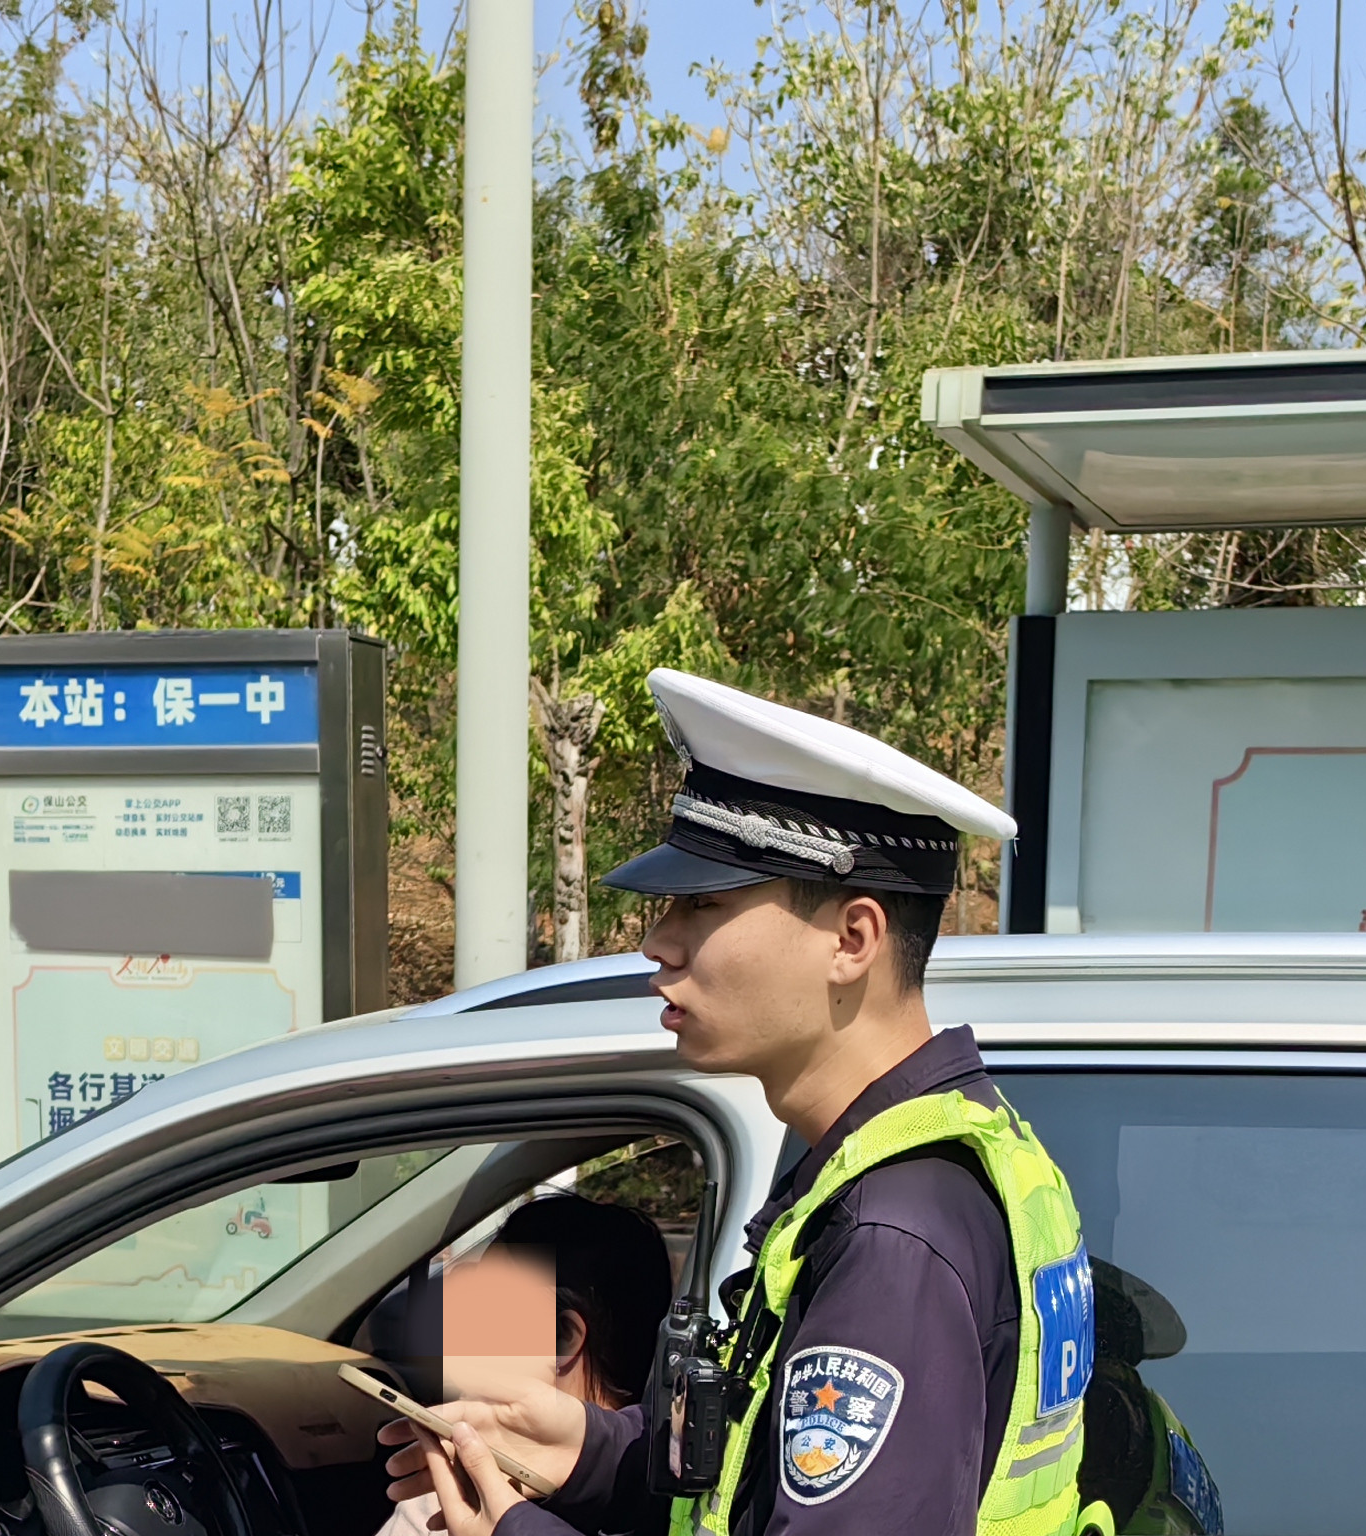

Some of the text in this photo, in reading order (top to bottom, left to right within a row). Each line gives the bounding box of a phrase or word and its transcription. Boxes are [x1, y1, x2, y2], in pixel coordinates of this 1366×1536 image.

[19, 675, 285, 728] 本站：保一中
[790, 1356, 892, 1400] 中华人民共和国
[801, 1414, 848, 1433] POLICE
